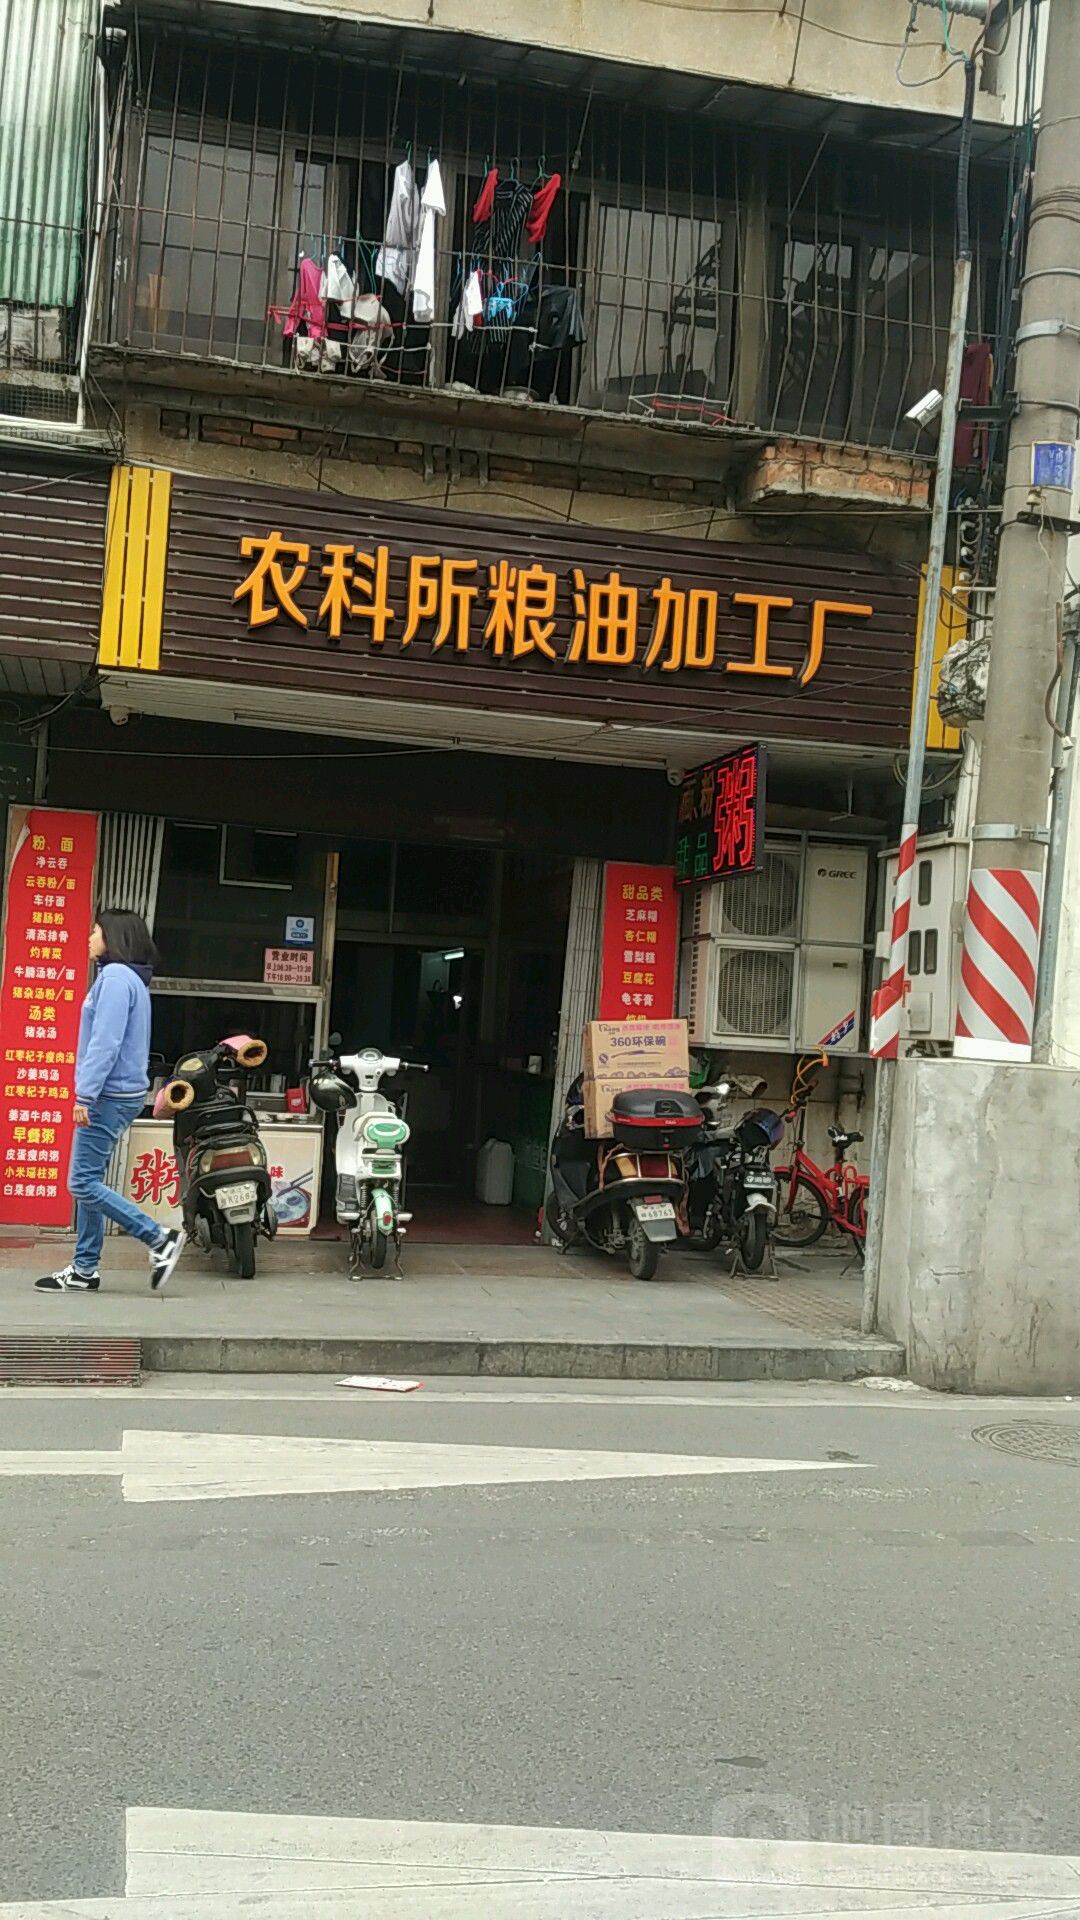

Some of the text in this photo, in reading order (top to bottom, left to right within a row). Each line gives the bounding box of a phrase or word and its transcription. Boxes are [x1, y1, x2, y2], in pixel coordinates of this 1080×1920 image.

[233, 530, 873, 687] 农科所粮油加工厂
[36, 857, 68, 870] 净云吞
[25, 875, 76, 890] 云吞粉/面
[622, 884, 664, 902] 甜品类
[33, 894, 65, 907] 车仔面
[32, 911, 65, 925] 猪肠粉
[625, 908, 658, 922] 芝麻糊
[25, 928, 69, 944] 清蒸排骨
[624, 930, 657, 944] 杏仁糊
[30, 947, 63, 960] 灼青菜
[271, 950, 308, 962] 营业时间
[621, 971, 655, 986] 豆腐花
[621, 992, 654, 1007] 龟苓膏
[28, 1005, 56, 1021] 汤类
[25, 1026, 57, 1040] 猪杂汤
[610, 1035, 667, 1047] 360环保碗
[5, 1049, 75, 1065] 红枣杞子瘦肉汤
[16, 1067, 60, 1081] 沙姜鸡汤
[5, 1085, 69, 1100] 红枣杞子鸡汤
[13, 1127, 56, 1145] 早餐粥
[5, 1149, 60, 1163] 皮蛋瘦肉粥
[3, 1183, 57, 1198] 白果瘦肉粥
